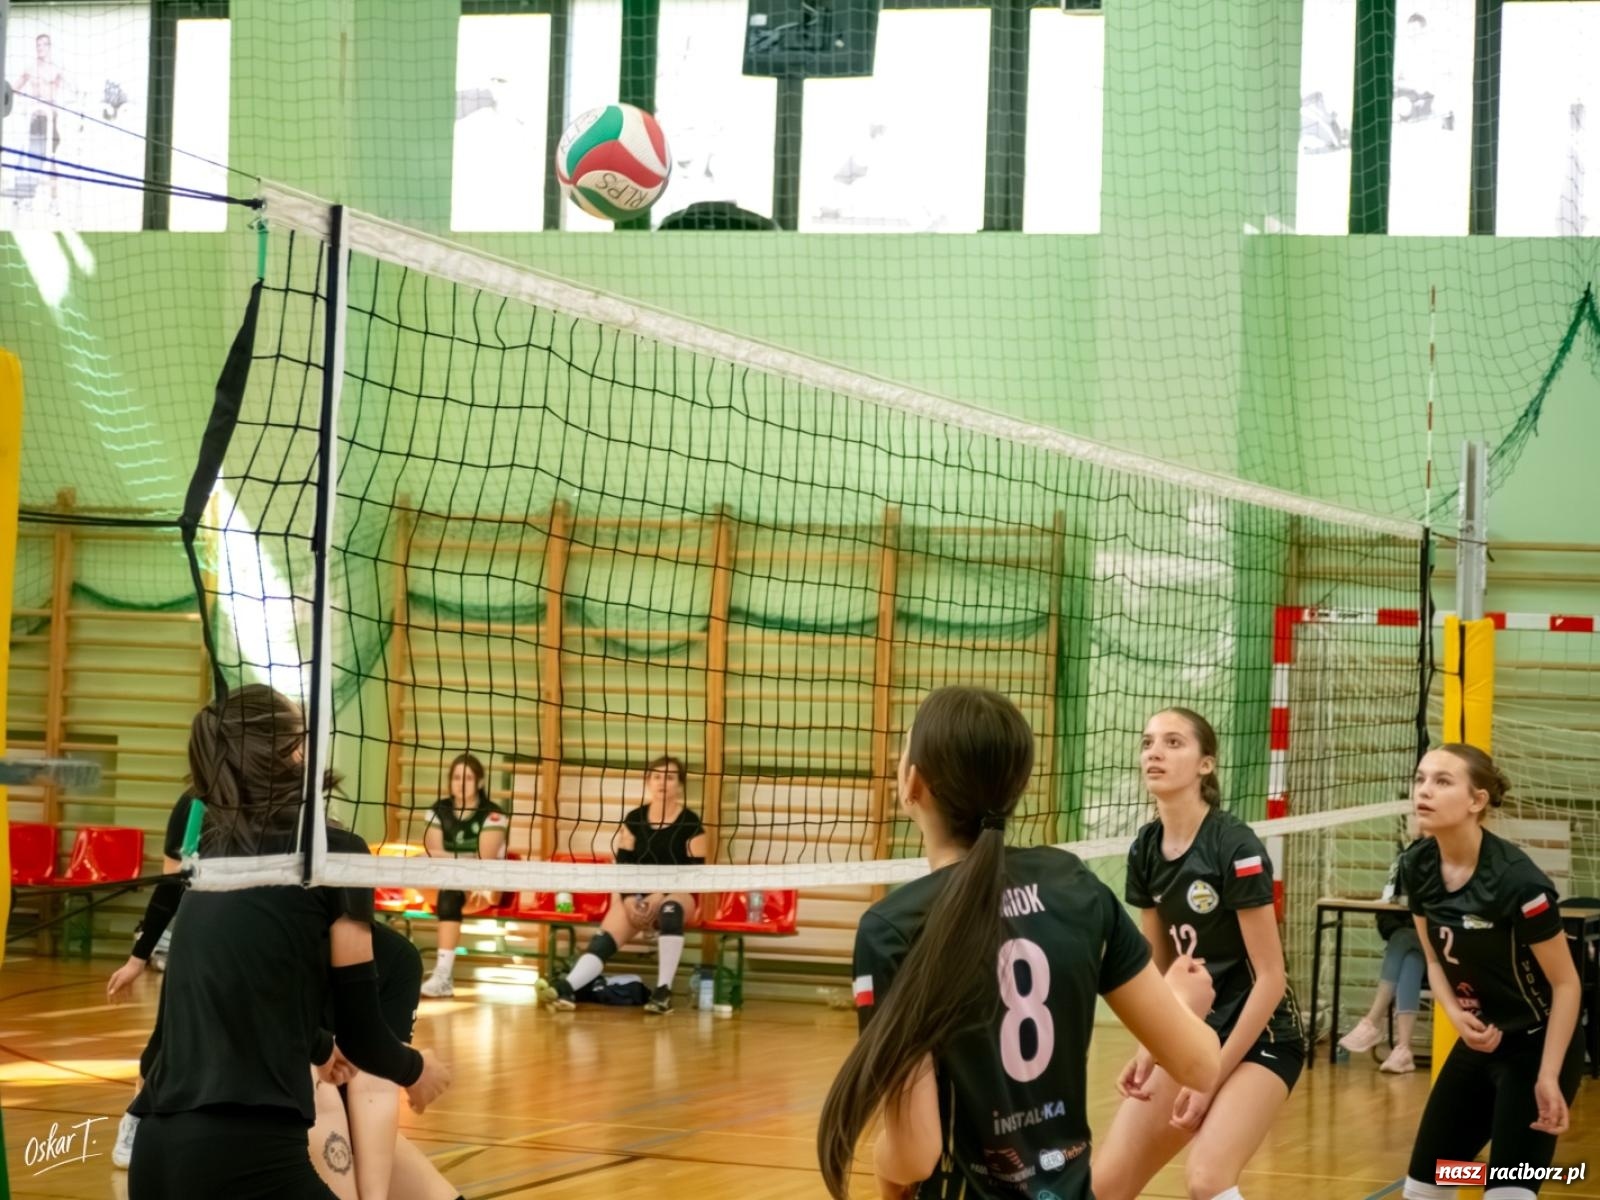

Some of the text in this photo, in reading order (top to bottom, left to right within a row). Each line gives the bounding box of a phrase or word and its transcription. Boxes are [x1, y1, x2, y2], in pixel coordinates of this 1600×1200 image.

[595, 172, 649, 208] RLPS
[1169, 923, 1206, 965] 12
[1440, 926, 1459, 965] 2
[997, 938, 1055, 1082] 8
